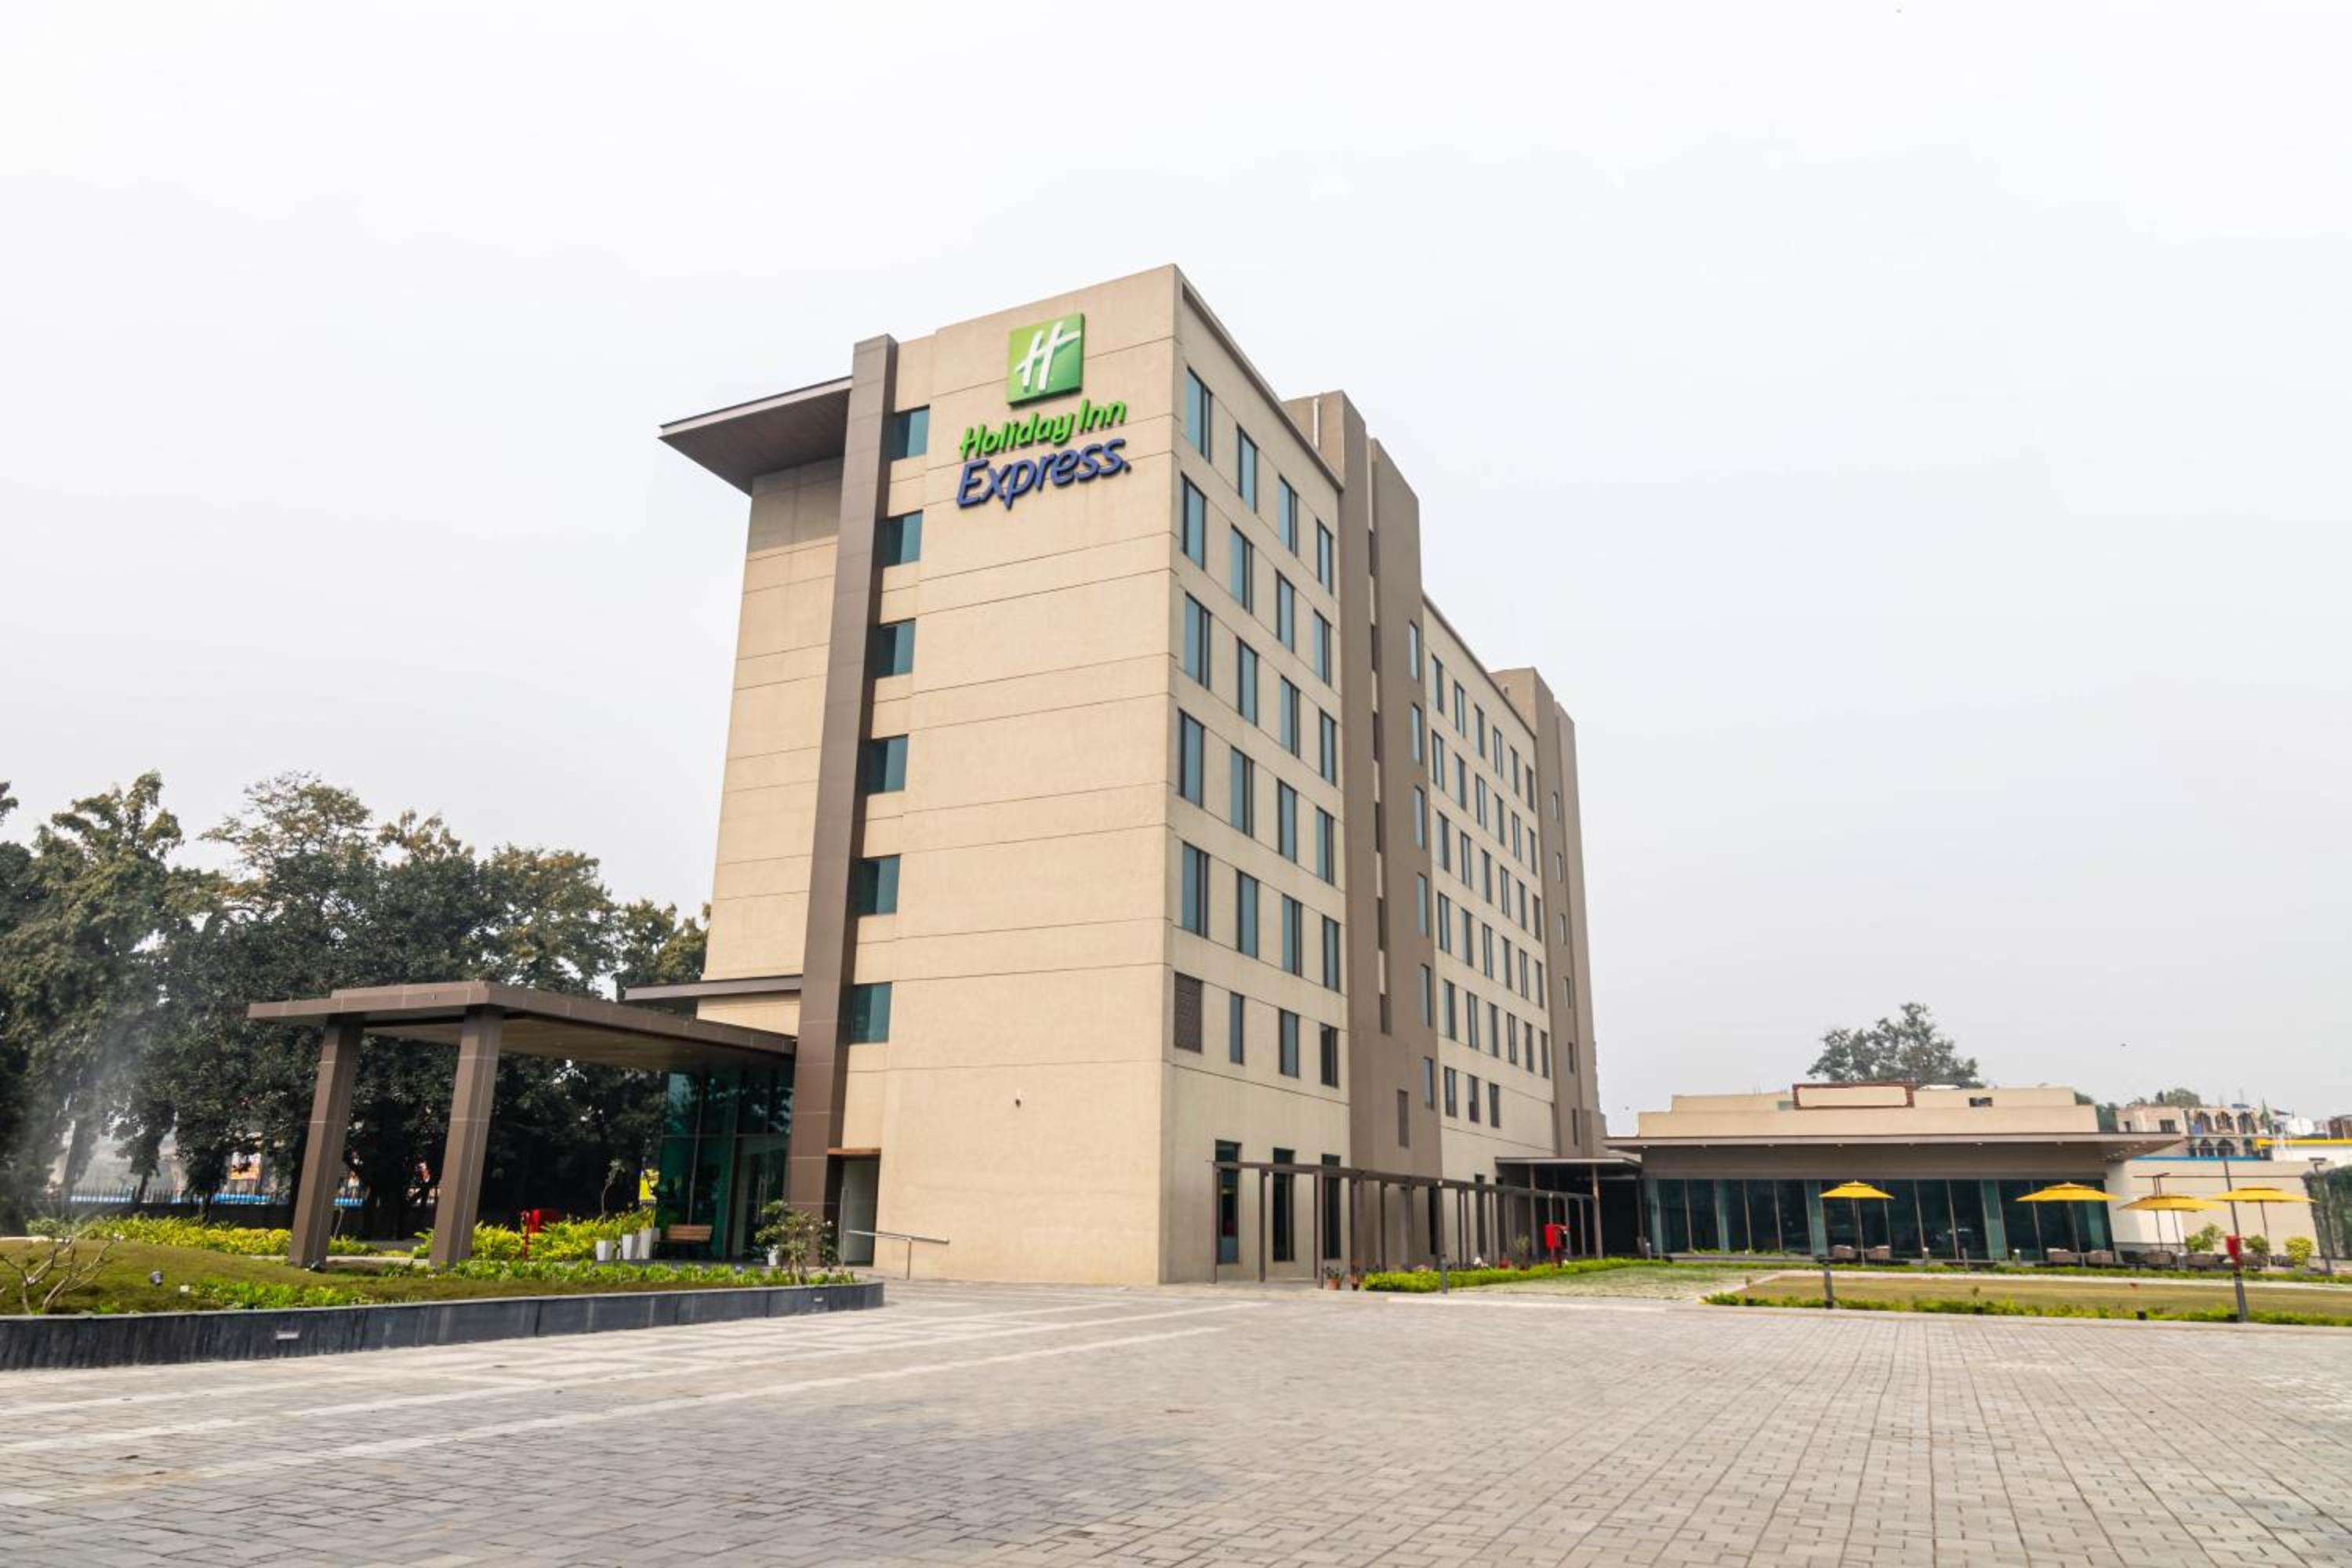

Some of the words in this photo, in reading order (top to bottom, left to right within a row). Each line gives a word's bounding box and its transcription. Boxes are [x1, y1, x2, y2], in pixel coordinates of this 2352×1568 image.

[1015, 321, 1080, 391] H
[960, 412, 1075, 461] Holiday
[1079, 398, 1127, 433] Inn
